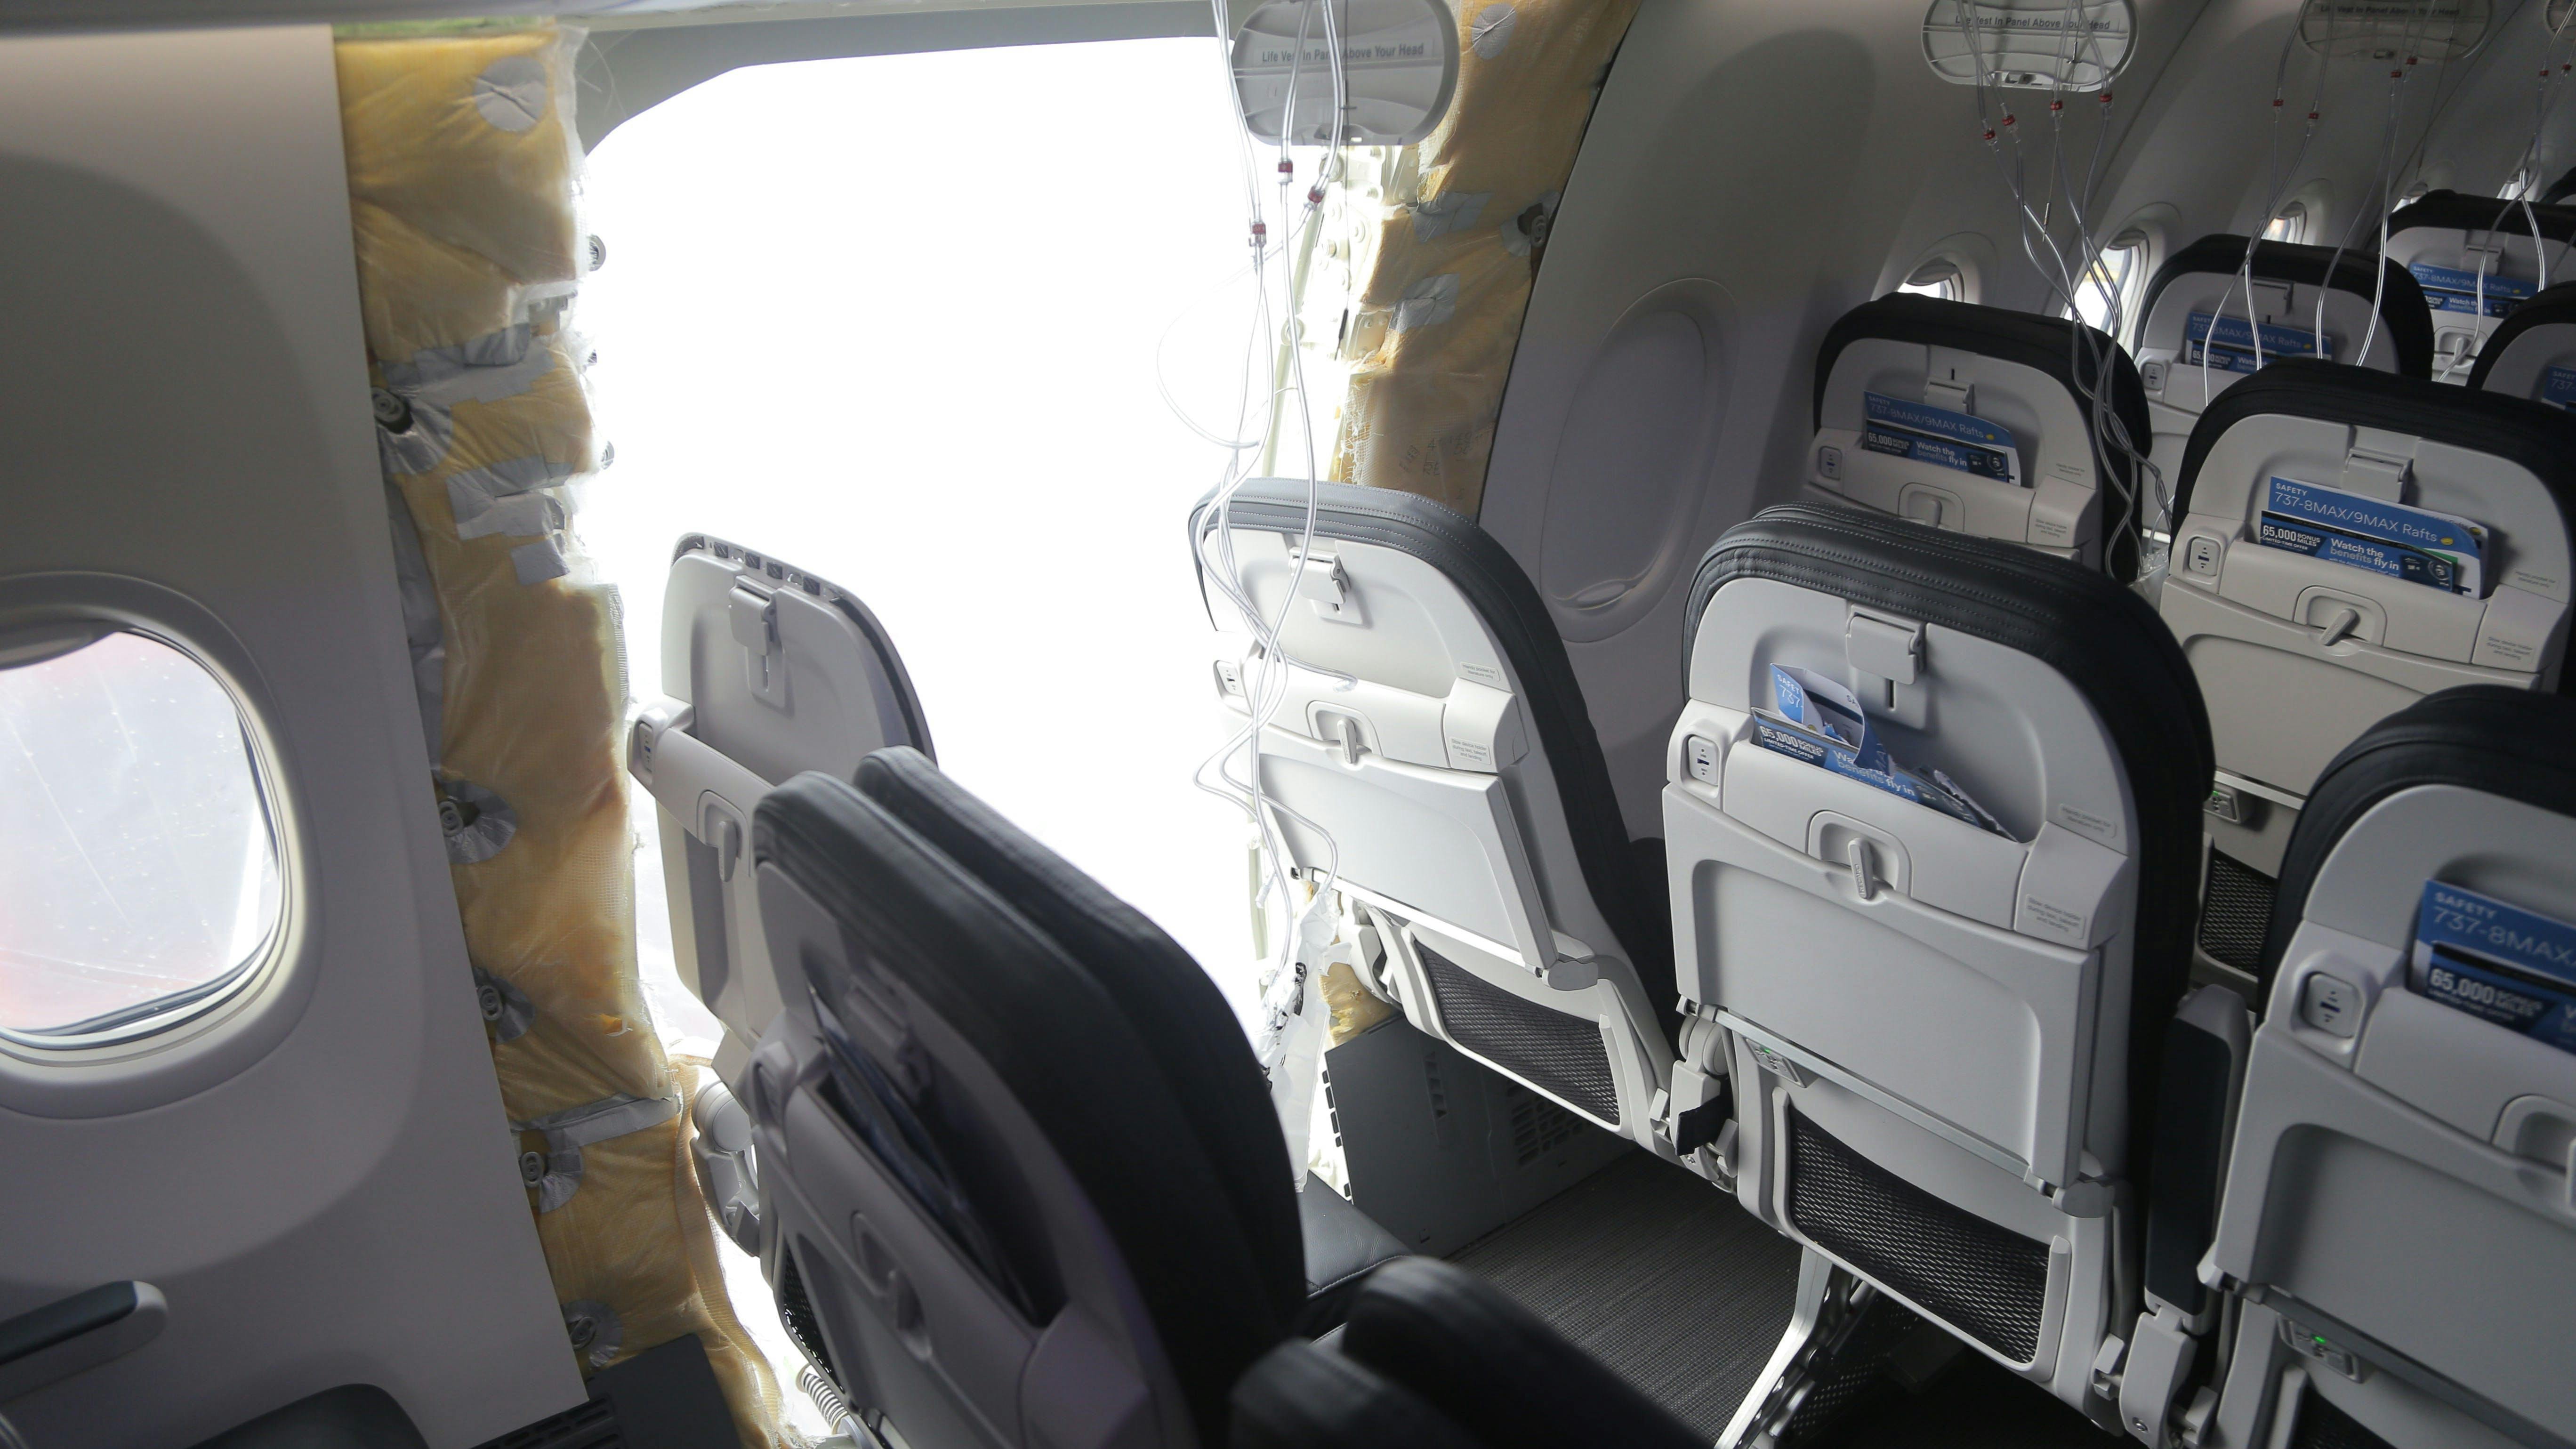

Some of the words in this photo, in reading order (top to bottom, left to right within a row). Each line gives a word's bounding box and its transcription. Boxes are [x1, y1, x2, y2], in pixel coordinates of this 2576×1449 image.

[1956, 16, 1971, 24] Le
[1995, 17, 2003, 25] In
[2005, 17, 2030, 26] Panel
[2033, 18, 2061, 27] Above
[1262, 50, 1278, 62] Life
[1303, 49, 1311, 60] In
[1343, 47, 1371, 58] Above
[1375, 45, 1396, 56] Your
[1399, 42, 1424, 56] Head
[1870, 403, 1957, 432] 737-8MAX/9MAX
[1959, 423, 1984, 438] Rafts
[1868, 432, 1892, 446] 65,000
[1916, 441, 1941, 454] Watch
[1942, 447, 1955, 457] the
[1916, 449, 1948, 461] benefits
[1948, 455, 1959, 467] fly
[1959, 457, 1967, 467] in
[2275, 483, 2308, 497] SAFETY
[2275, 491, 2399, 532] 737-8MAX/9MAX
[2402, 523, 2438, 543] Rafts
[2262, 524, 2296, 541] 65,000
[2297, 533, 2321, 543] BONUS
[2297, 538, 2317, 547] MILES
[2331, 538, 2365, 554] Watch
[2366, 547, 2384, 558] the
[2330, 546, 2372, 564] benefits
[2374, 557, 2388, 569] fly
[2389, 560, 2399, 571] in
[1777, 674, 1803, 694] SAFET
[1760, 725, 1799, 748] 65,000
[1886, 778, 1900, 792] fly
[1904, 784, 1916, 797] in
[2434, 891, 2498, 919] SAFETY
[2430, 968, 2495, 1005] 65,000
